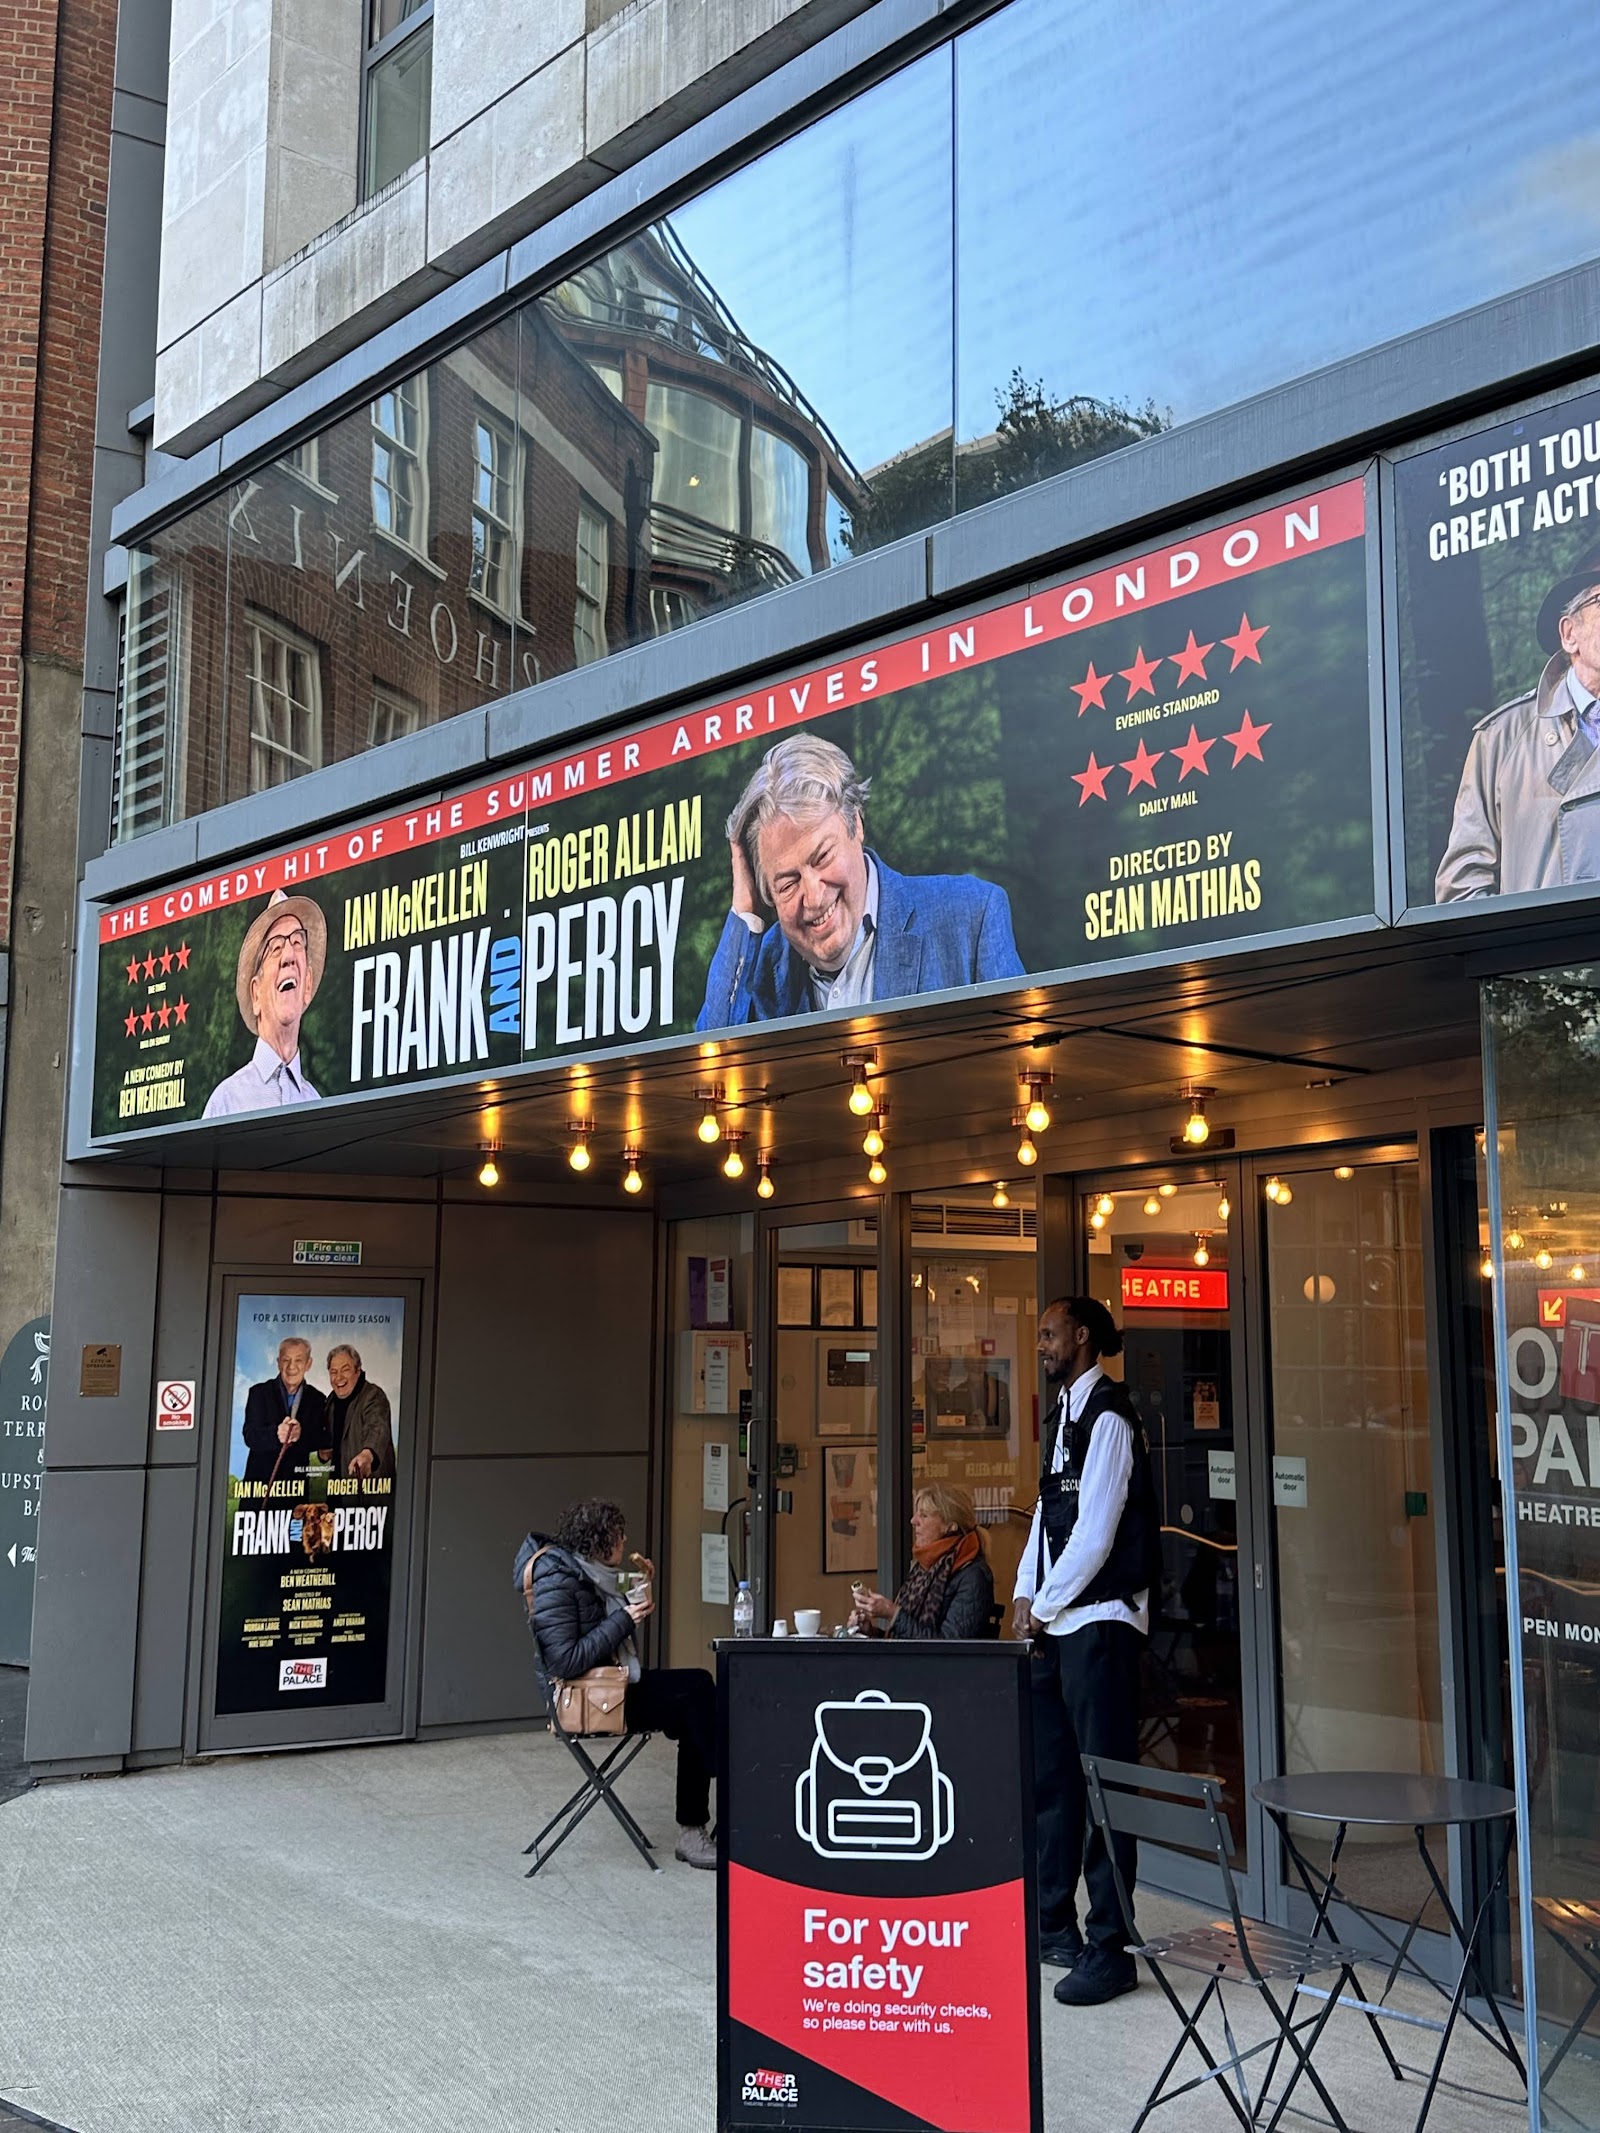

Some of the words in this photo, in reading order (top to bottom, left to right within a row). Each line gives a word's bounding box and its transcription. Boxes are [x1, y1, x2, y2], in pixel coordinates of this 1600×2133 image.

[1429, 497, 1525, 561] GREAT
[1533, 472, 1600, 532] ACT
[109, 911, 149, 936] THE
[163, 867, 267, 918] COMEDY
[283, 846, 330, 881] HIT
[348, 829, 384, 860] OF
[405, 803, 464, 842] THE
[486, 742, 642, 816] SUMMER
[671, 660, 879, 756] ARRIVES
[921, 626, 975, 673] IN
[1024, 504, 1321, 638] LONDON
[1116, 704, 1161, 731] EVENING
[1162, 689, 1220, 717] STANDARD
[1139, 795, 1169, 817] DAILY
[1170, 790, 1198, 810] MAIL
[460, 842, 477, 859] BILL
[477, 825, 525, 852] KENWRIGHT
[528, 823, 609, 902] ROGER
[614, 795, 702, 880] ALLAM
[1109, 839, 1202, 881] DIRECTED
[1207, 831, 1233, 860] BY
[343, 891, 377, 952] IAN
[380, 859, 488, 942] McKELLEN
[1084, 883, 1145, 941] SEAN
[1151, 859, 1261, 929] MATHIAS
[350, 926, 492, 1082] FRANK
[489, 935, 521, 1035] AND
[523, 876, 685, 1051] PERCY
[124, 1070, 131, 1085] A
[130, 1066, 146, 1084] NEW
[146, 1061, 174, 1081] COMEDY
[174, 1059, 184, 1075] BY
[119, 1088, 135, 1119] BEN
[137, 1078, 185, 1115] WEATHERILL
[313, 1243, 332, 1252] Fire
[335, 1244, 353, 1252] exit
[308, 1254, 330, 1262] Keep
[333, 1254, 356, 1262] clear
[1122, 1278, 1201, 1298] HEATRE
[253, 1313, 271, 1322] FOR
[272, 1314, 279, 1322] A
[281, 1313, 320, 1323] STRICTLY
[321, 1314, 356, 1323] LIMITED
[358, 1314, 391, 1324] SEASON
[21, 1394, 47, 1411] RO
[327, 1478, 358, 1496] ROGER
[1217, 1476, 1231, 1484] door
[1275, 1472, 1305, 1482] Automatic
[1283, 1482, 1297, 1491] door
[233, 1481, 252, 1498] IAN
[232, 1509, 293, 1557] FRANK
[332, 1506, 388, 1552] PERCY
[280, 1575, 294, 1588] BEN
[295, 1573, 336, 1587] WEATHERILL
[282, 1598, 300, 1612] SEAN
[301, 1597, 332, 1610] MATHIAS
[1523, 1617, 1559, 1638] PEN
[285, 1662, 322, 1675] OTHER
[283, 1674, 323, 1686] PALACE
[804, 1908, 869, 1944] For
[878, 1918, 969, 1953] your
[802, 1954, 924, 1998] safety
[802, 1998, 841, 2012] We're
[843, 2000, 881, 2017] doing
[884, 2001, 937, 2019] security
[939, 2002, 992, 2020] checks,
[802, 2017, 820, 2029] so
[822, 2015, 867, 2032] please
[869, 2016, 900, 2031] bear
[903, 2018, 931, 2033] with
[934, 2021, 954, 2034] us.
[744, 2070, 796, 2088] OTHER
[741, 2087, 799, 2102] PALACE
